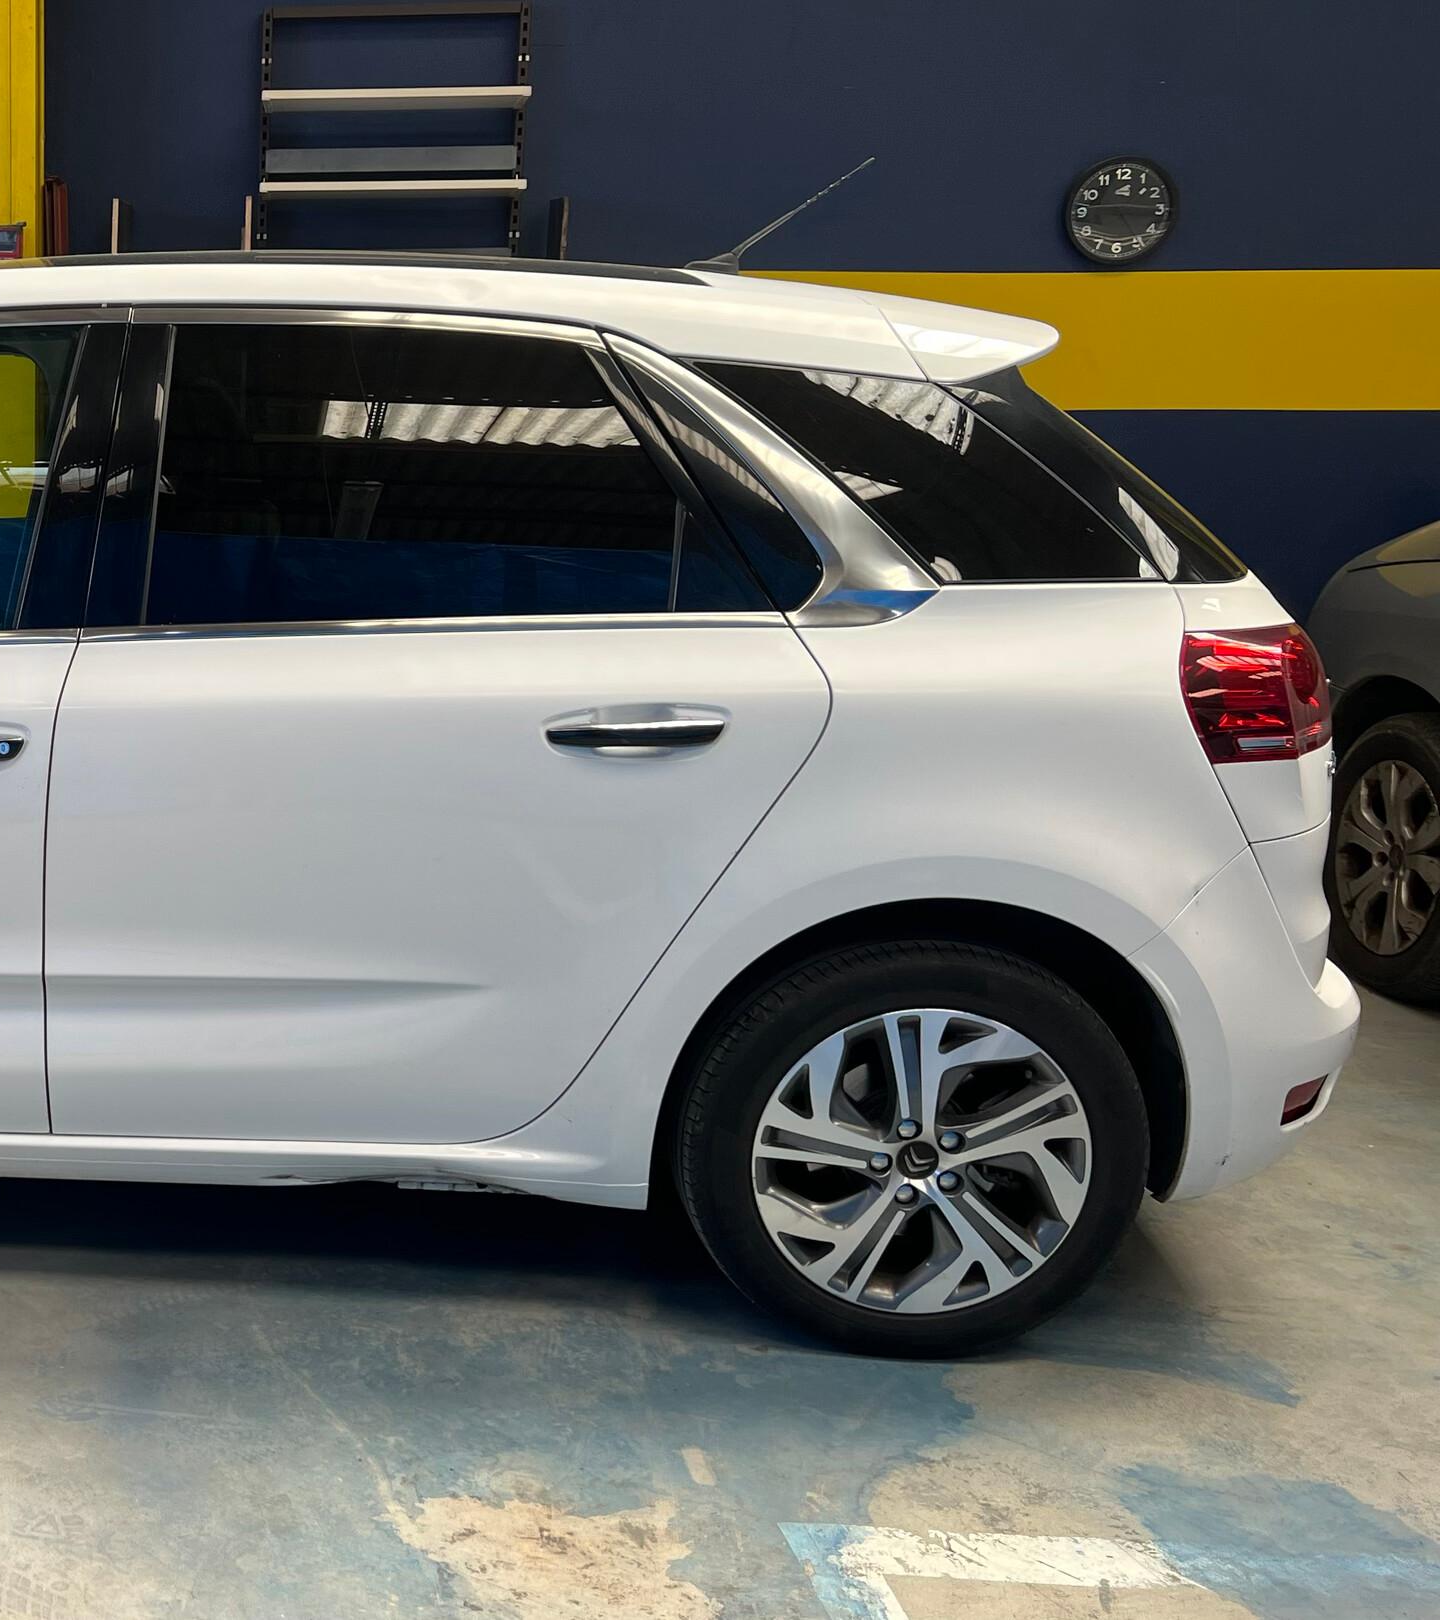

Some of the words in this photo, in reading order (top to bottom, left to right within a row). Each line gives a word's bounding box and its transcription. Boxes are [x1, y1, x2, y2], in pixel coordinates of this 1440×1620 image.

[1116, 169, 1132, 180] 12
[1140, 173, 1146, 184] 1
[1098, 175, 1110, 186] 11
[1083, 189, 1098, 200] 10
[1150, 187, 1160, 198] 2
[1077, 207, 1088, 218] 9
[1155, 204, 1165, 215] 3
[1080, 226, 1092, 236] 8
[1146, 223, 1156, 234] 4
[1094, 239, 1104, 250] 7
[1111, 242, 1122, 253] 6
